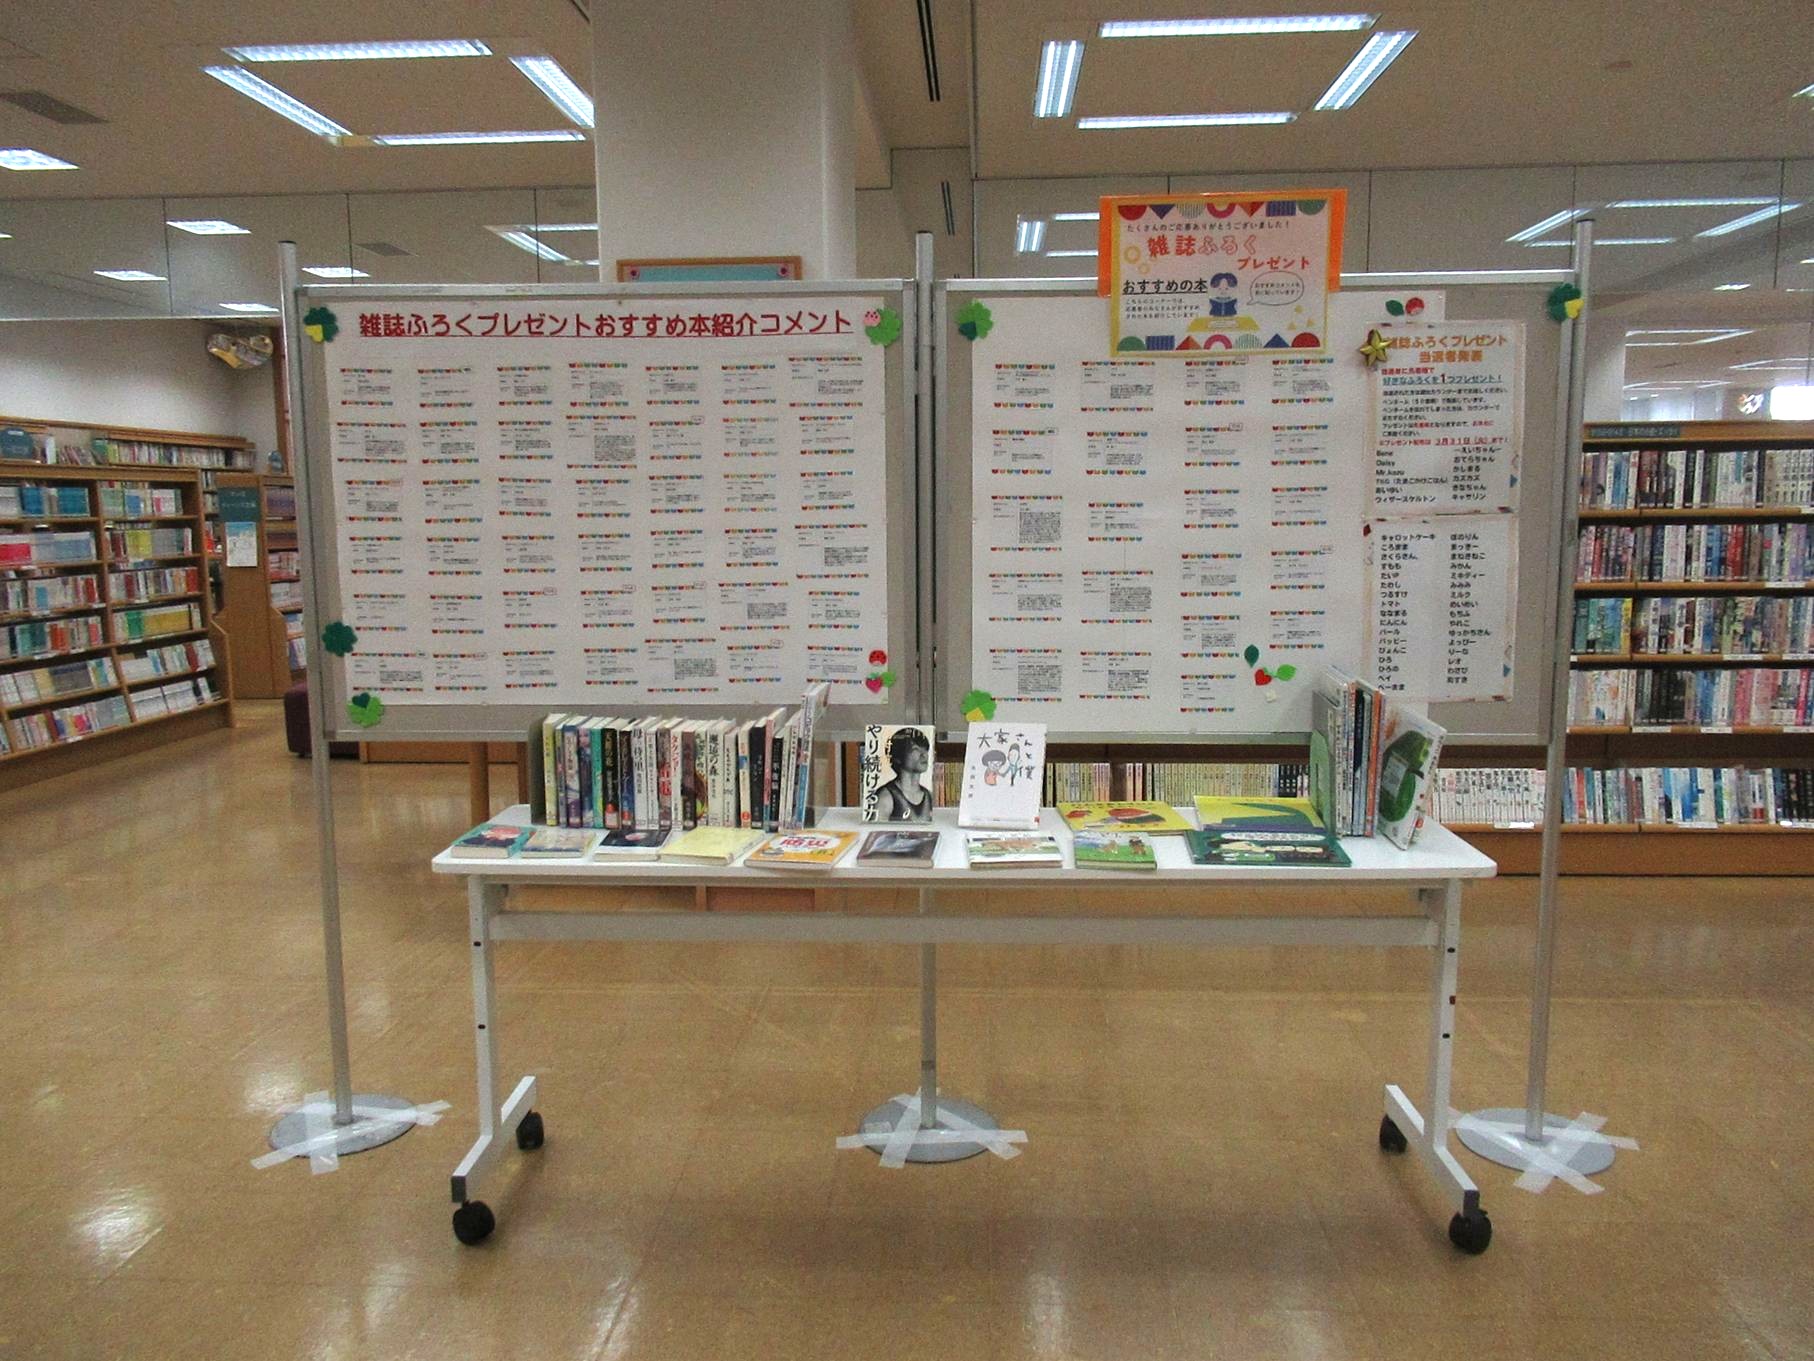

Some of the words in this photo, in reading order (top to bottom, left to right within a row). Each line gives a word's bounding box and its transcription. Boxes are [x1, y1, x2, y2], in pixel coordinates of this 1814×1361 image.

[1147, 234, 1258, 257] 雑誌ふろく
[1237, 256, 1311, 271] プレゼント
[1122, 278, 1208, 294] おすすめの本
[359, 309, 852, 337] 雑誌ふろくプレゼントおすすめ本紹介コメント
[977, 729, 1036, 780] 大家さんと僕
[864, 724, 882, 822] やり続ける力
